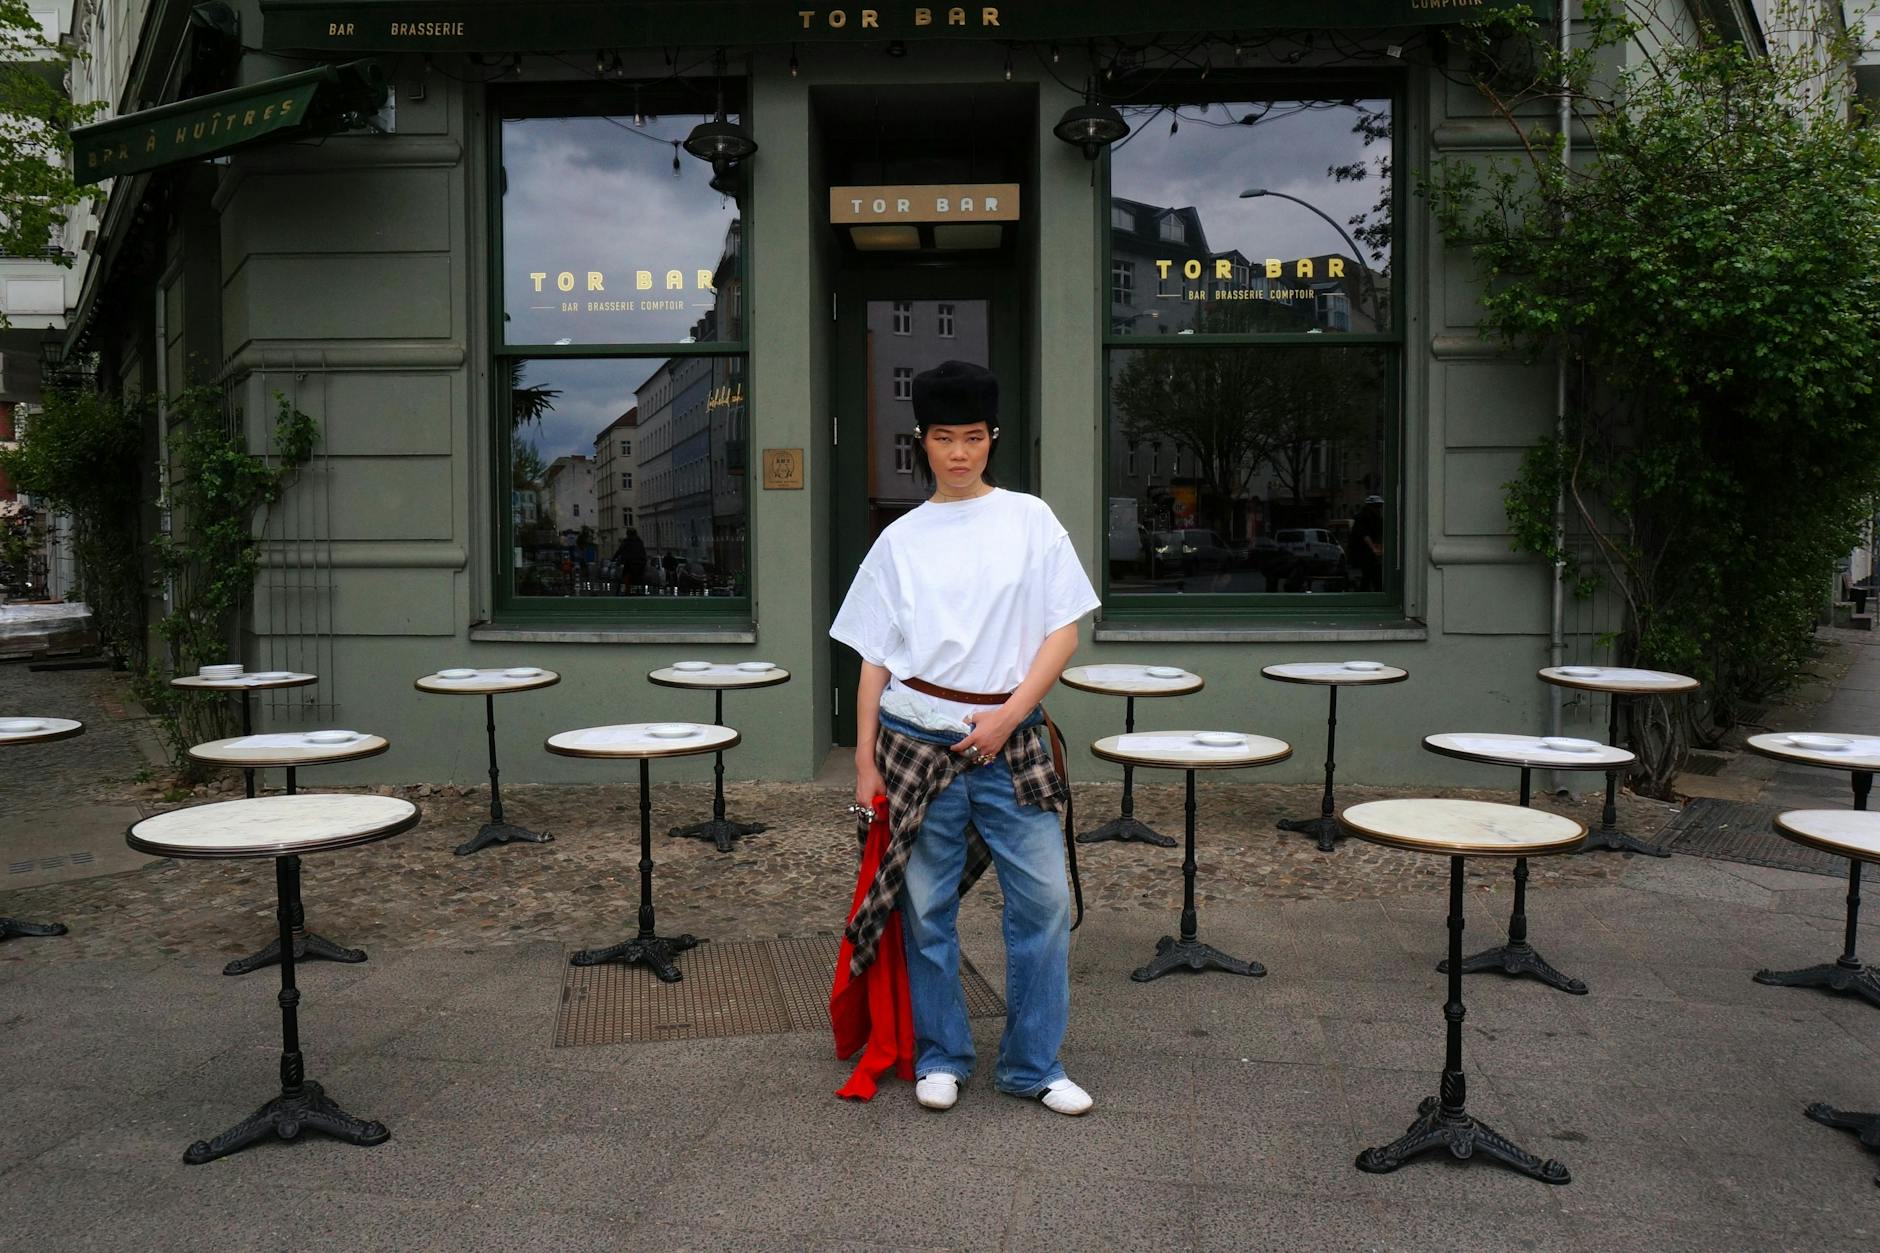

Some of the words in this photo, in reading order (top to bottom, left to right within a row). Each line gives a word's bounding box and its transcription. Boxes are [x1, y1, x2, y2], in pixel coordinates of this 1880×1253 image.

[798, 9, 880, 29] TOR
[915, 7, 1000, 27] BAR
[328, 23, 355, 36] BAR
[391, 22, 465, 36] BRASSERIE
[146, 129, 156, 151] À
[175, 99, 294, 144] HUÎTRES
[851, 198, 910, 214] TOR
[936, 197, 999, 213] BAR
[1156, 259, 1233, 280] TOR
[1265, 258, 1345, 279] BAR
[530, 271, 605, 292] TOR
[636, 269, 716, 290] BAR
[1188, 289, 1206, 300] BAR
[1215, 289, 1264, 300] BRASSERIE
[1270, 288, 1315, 300] COMPTOIR
[562, 302, 579, 312] BAR
[587, 301, 634, 312] BRASSERIE
[640, 300, 684, 311] COMPTOIR
